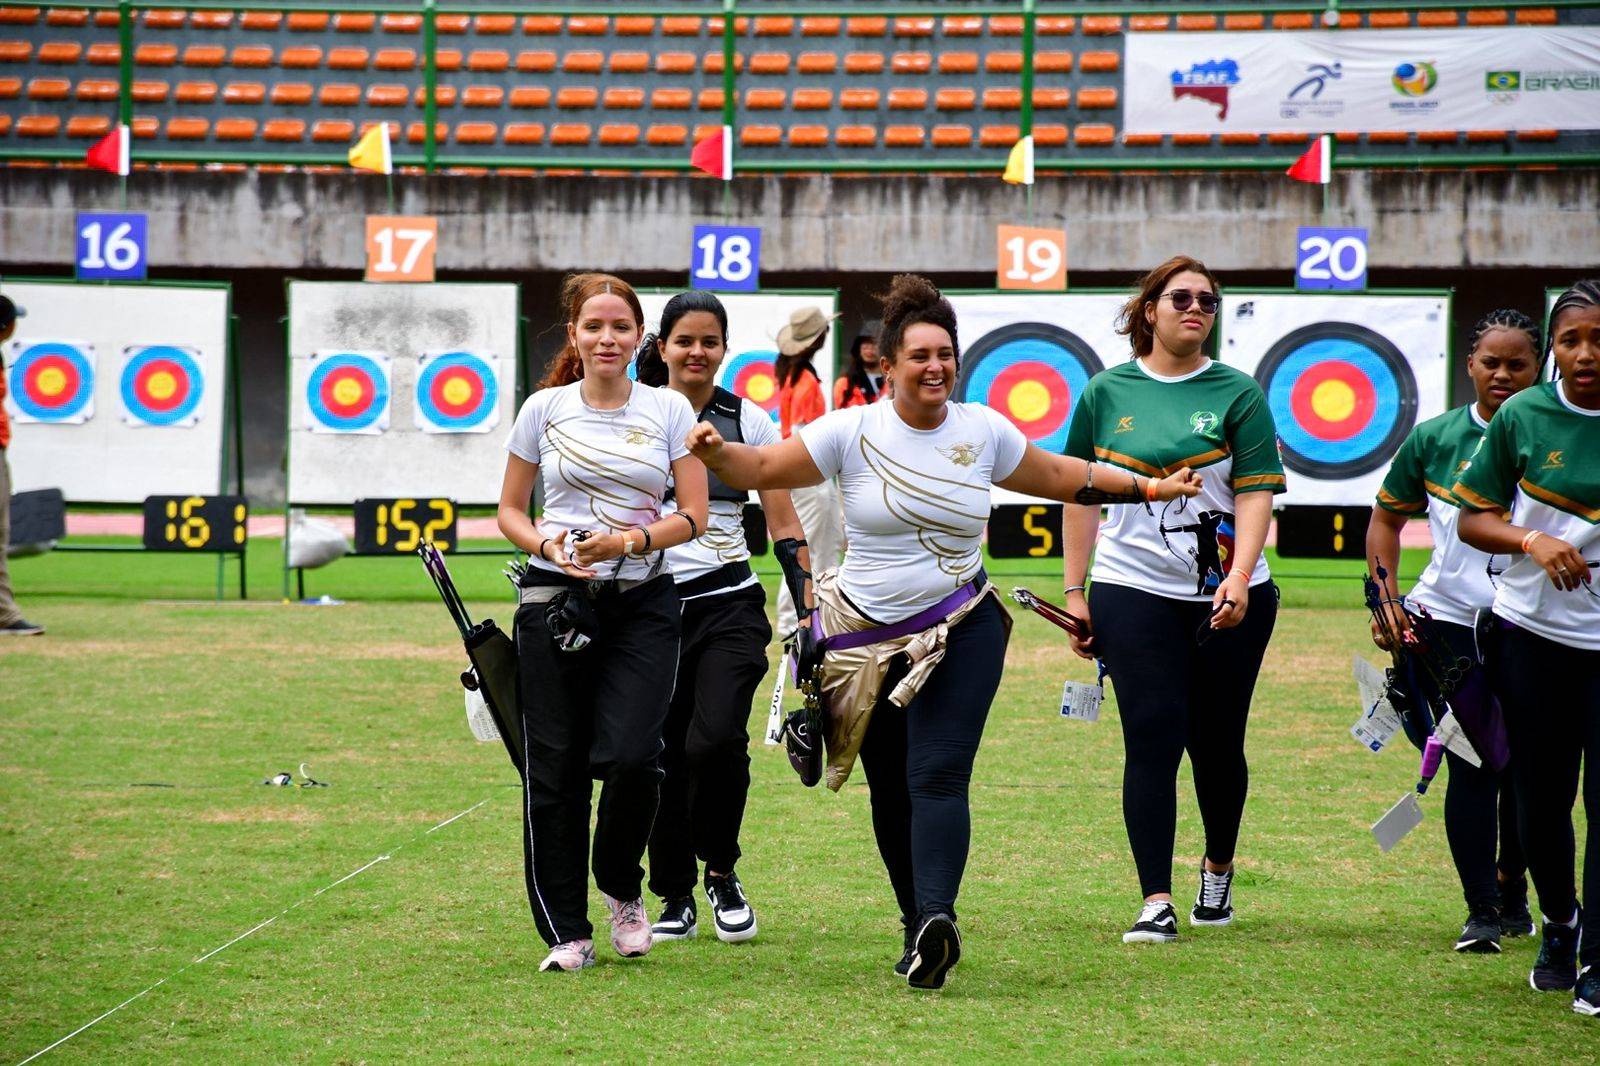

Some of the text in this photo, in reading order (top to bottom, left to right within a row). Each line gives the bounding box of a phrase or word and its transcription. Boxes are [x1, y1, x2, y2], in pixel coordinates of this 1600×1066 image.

[81, 223, 140, 270] 16
[374, 227, 433, 273] 17
[696, 234, 752, 282] 18
[1005, 236, 1061, 284] 19
[1300, 237, 1366, 281] 20
[377, 499, 453, 552] 152
[1334, 514, 1343, 551] 1
